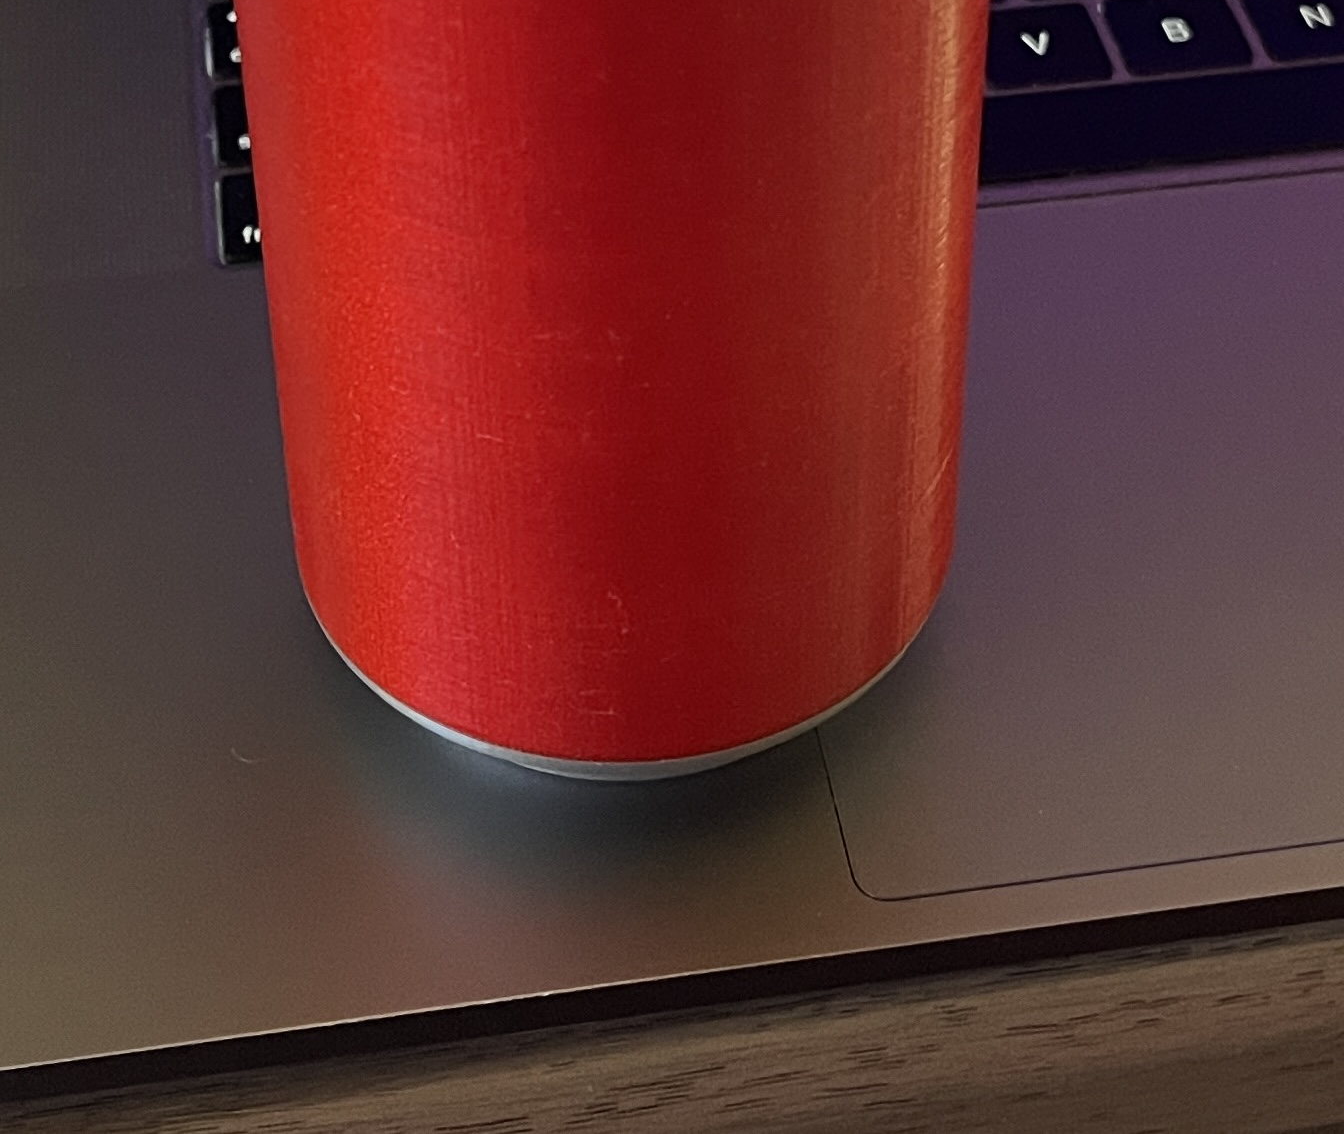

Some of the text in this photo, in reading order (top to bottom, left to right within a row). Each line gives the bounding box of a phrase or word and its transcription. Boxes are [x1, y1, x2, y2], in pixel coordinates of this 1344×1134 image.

[1299, 3, 1333, 29] N
[1160, 18, 1191, 43] B
[1020, 31, 1050, 56] V
